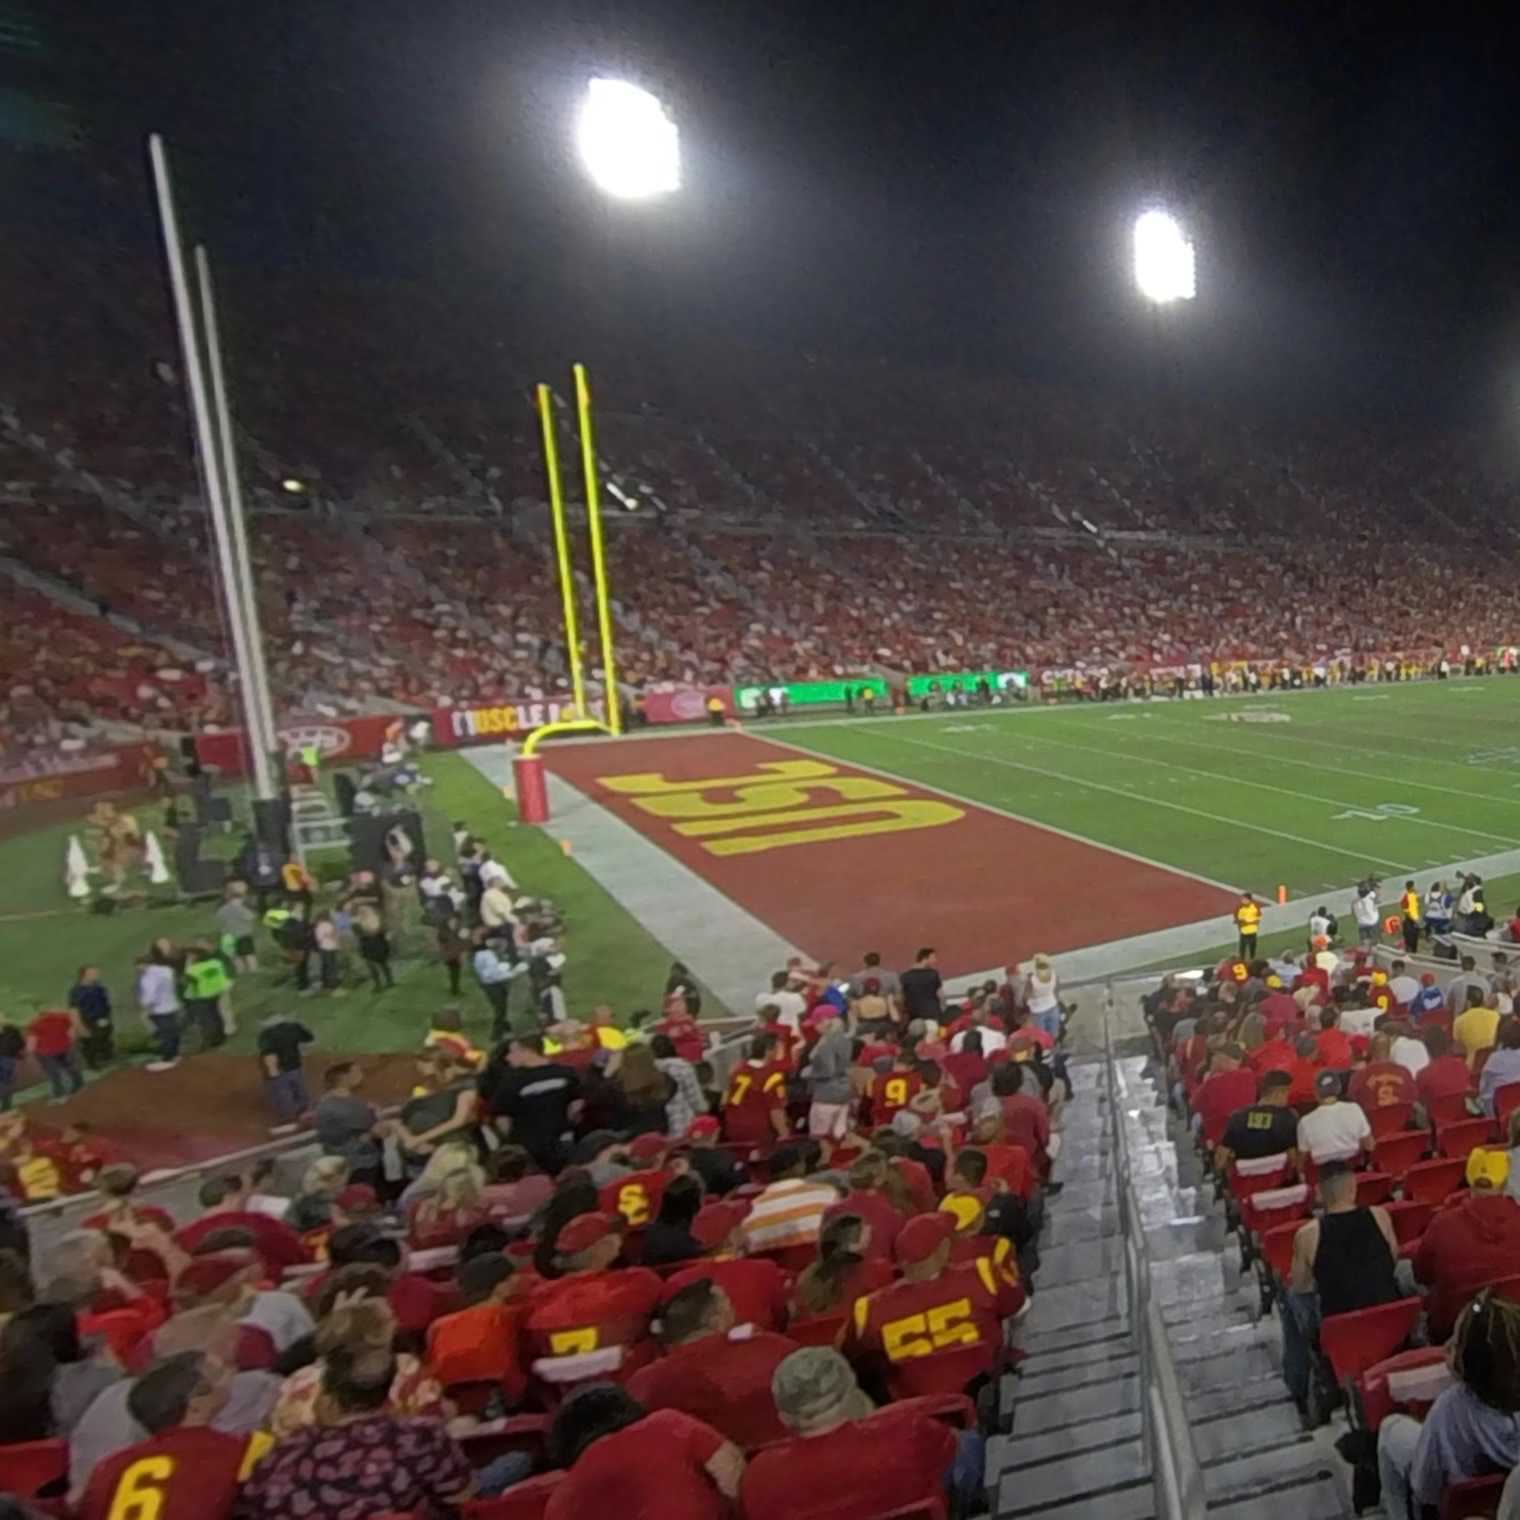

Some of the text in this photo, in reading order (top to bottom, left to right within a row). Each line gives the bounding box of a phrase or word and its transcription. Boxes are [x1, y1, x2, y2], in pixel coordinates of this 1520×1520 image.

[595, 759, 967, 857] USC
[730, 1075, 751, 1105] 7
[885, 1079, 907, 1107] 9
[881, 1298, 981, 1362] 55
[107, 1455, 176, 1520] 6
